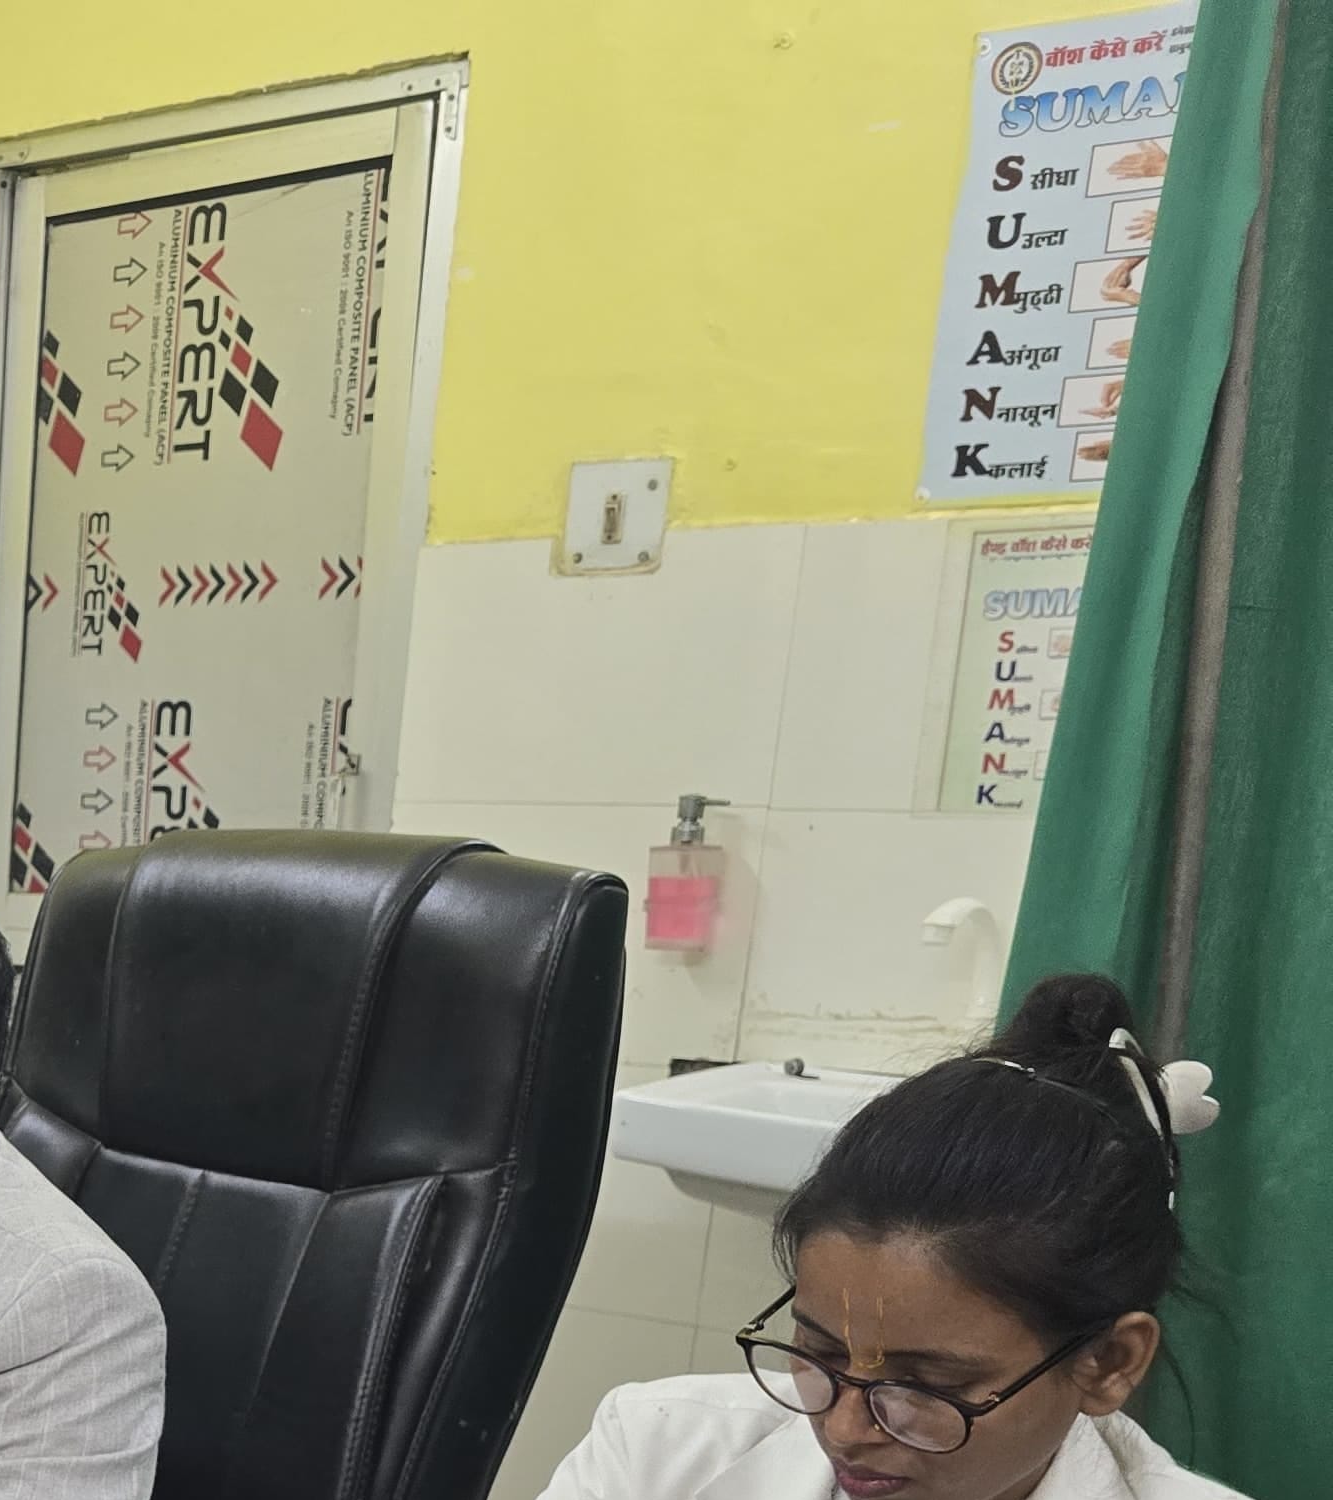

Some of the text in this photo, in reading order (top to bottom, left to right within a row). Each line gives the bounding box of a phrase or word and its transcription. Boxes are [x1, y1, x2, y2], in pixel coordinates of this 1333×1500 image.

[1044, 45, 1087, 68] वॉश
[1090, 37, 1130, 61] कैसे
[1133, 29, 1168, 55] करें
[999, 71, 1187, 138] SUMA
[992, 155, 1079, 191] S सीधा
[986, 212, 1068, 249] U उल्टा
[166, 209, 183, 292] ALUMINIUM
[350, 256, 367, 343] COMPOSITE
[975, 271, 1021, 308] M
[159, 296, 177, 378] COMPOSITE
[173, 201, 239, 460] EXPERT
[966, 330, 1005, 366] A
[346, 347, 360, 394] PANEL
[157, 382, 171, 423] PANEL
[960, 386, 1002, 421] N
[950, 443, 1048, 480] K कलाई
[80, 511, 115, 656] EXPERT
[997, 630, 1015, 653] S
[995, 660, 1016, 682] U
[987, 688, 1015, 711] M
[984, 721, 1005, 742] A
[150, 700, 205, 842] EXP
[981, 752, 1006, 774] N
[976, 784, 997, 805] K
